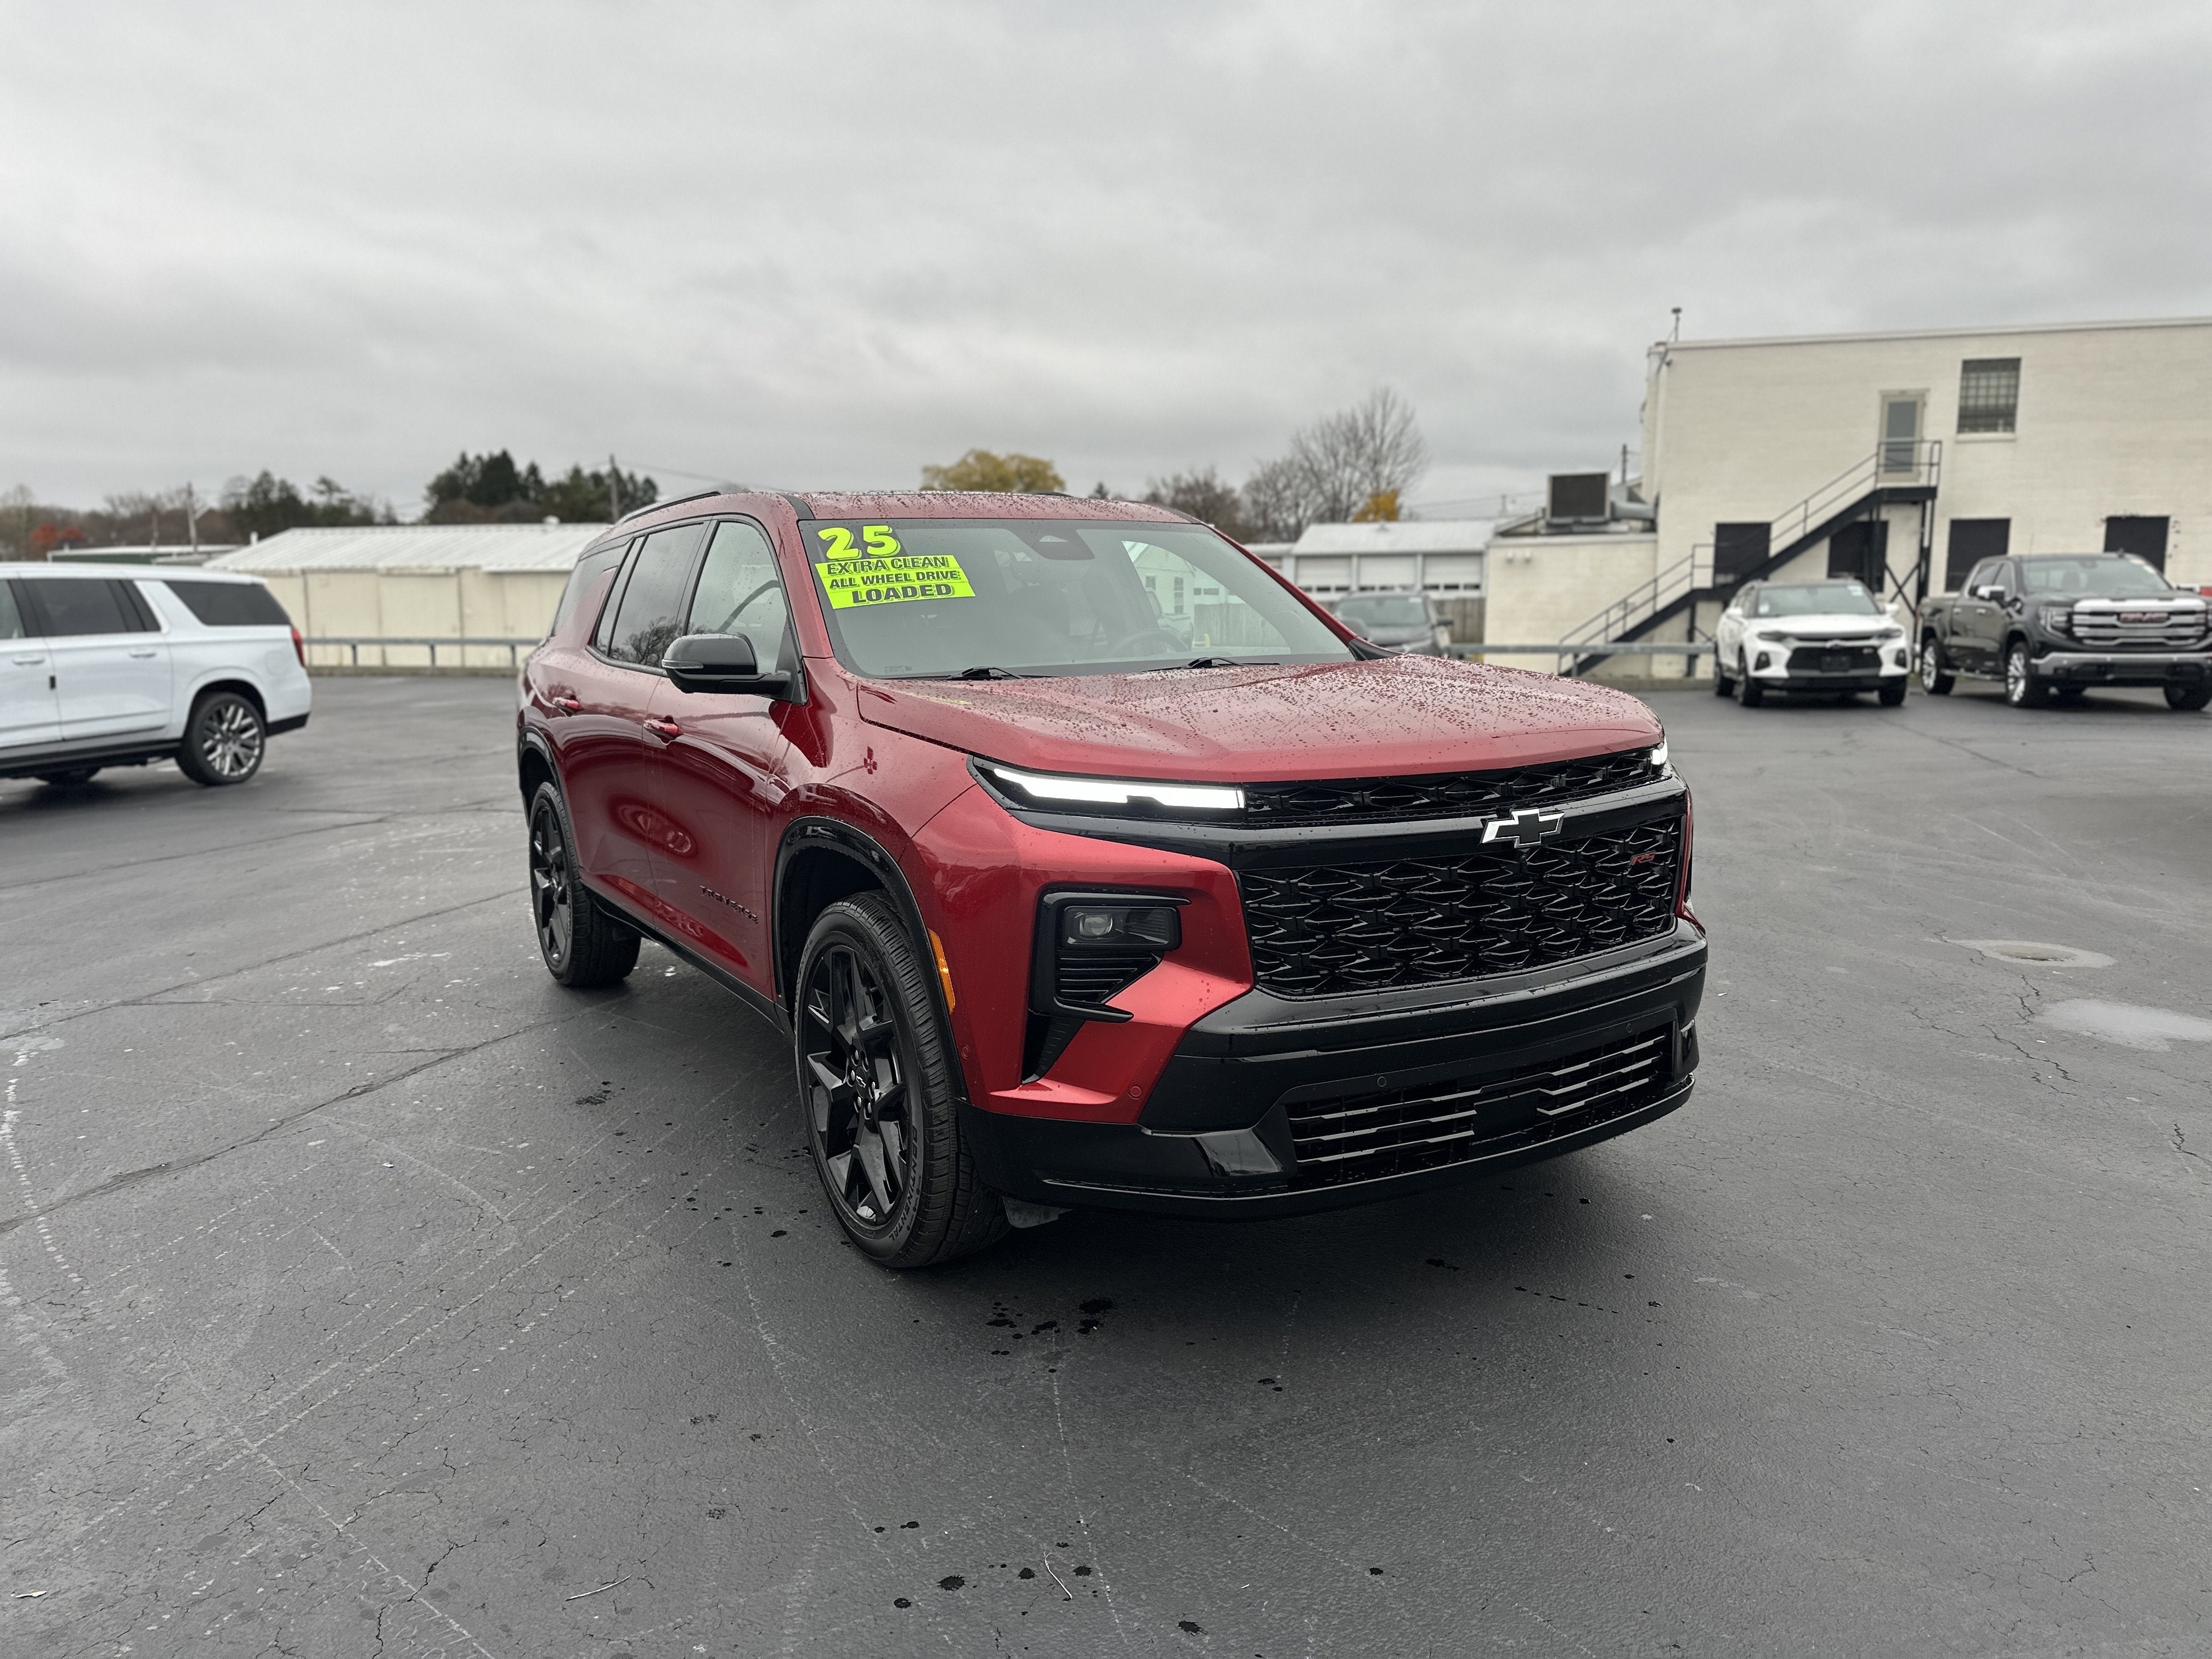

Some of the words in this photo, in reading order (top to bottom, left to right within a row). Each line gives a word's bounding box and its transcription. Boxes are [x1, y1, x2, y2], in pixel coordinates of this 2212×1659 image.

[818, 525, 901, 561] 25
[827, 559, 890, 576] EXTRA
[890, 556, 949, 569] CLEAN
[830, 578, 860, 590] ALL
[861, 573, 915, 586] WHEEL
[916, 571, 961, 581] DRIVE
[852, 584, 955, 604] LOADED
[1629, 850, 1656, 866] RS
[700, 885, 759, 924] TRAVERSE
